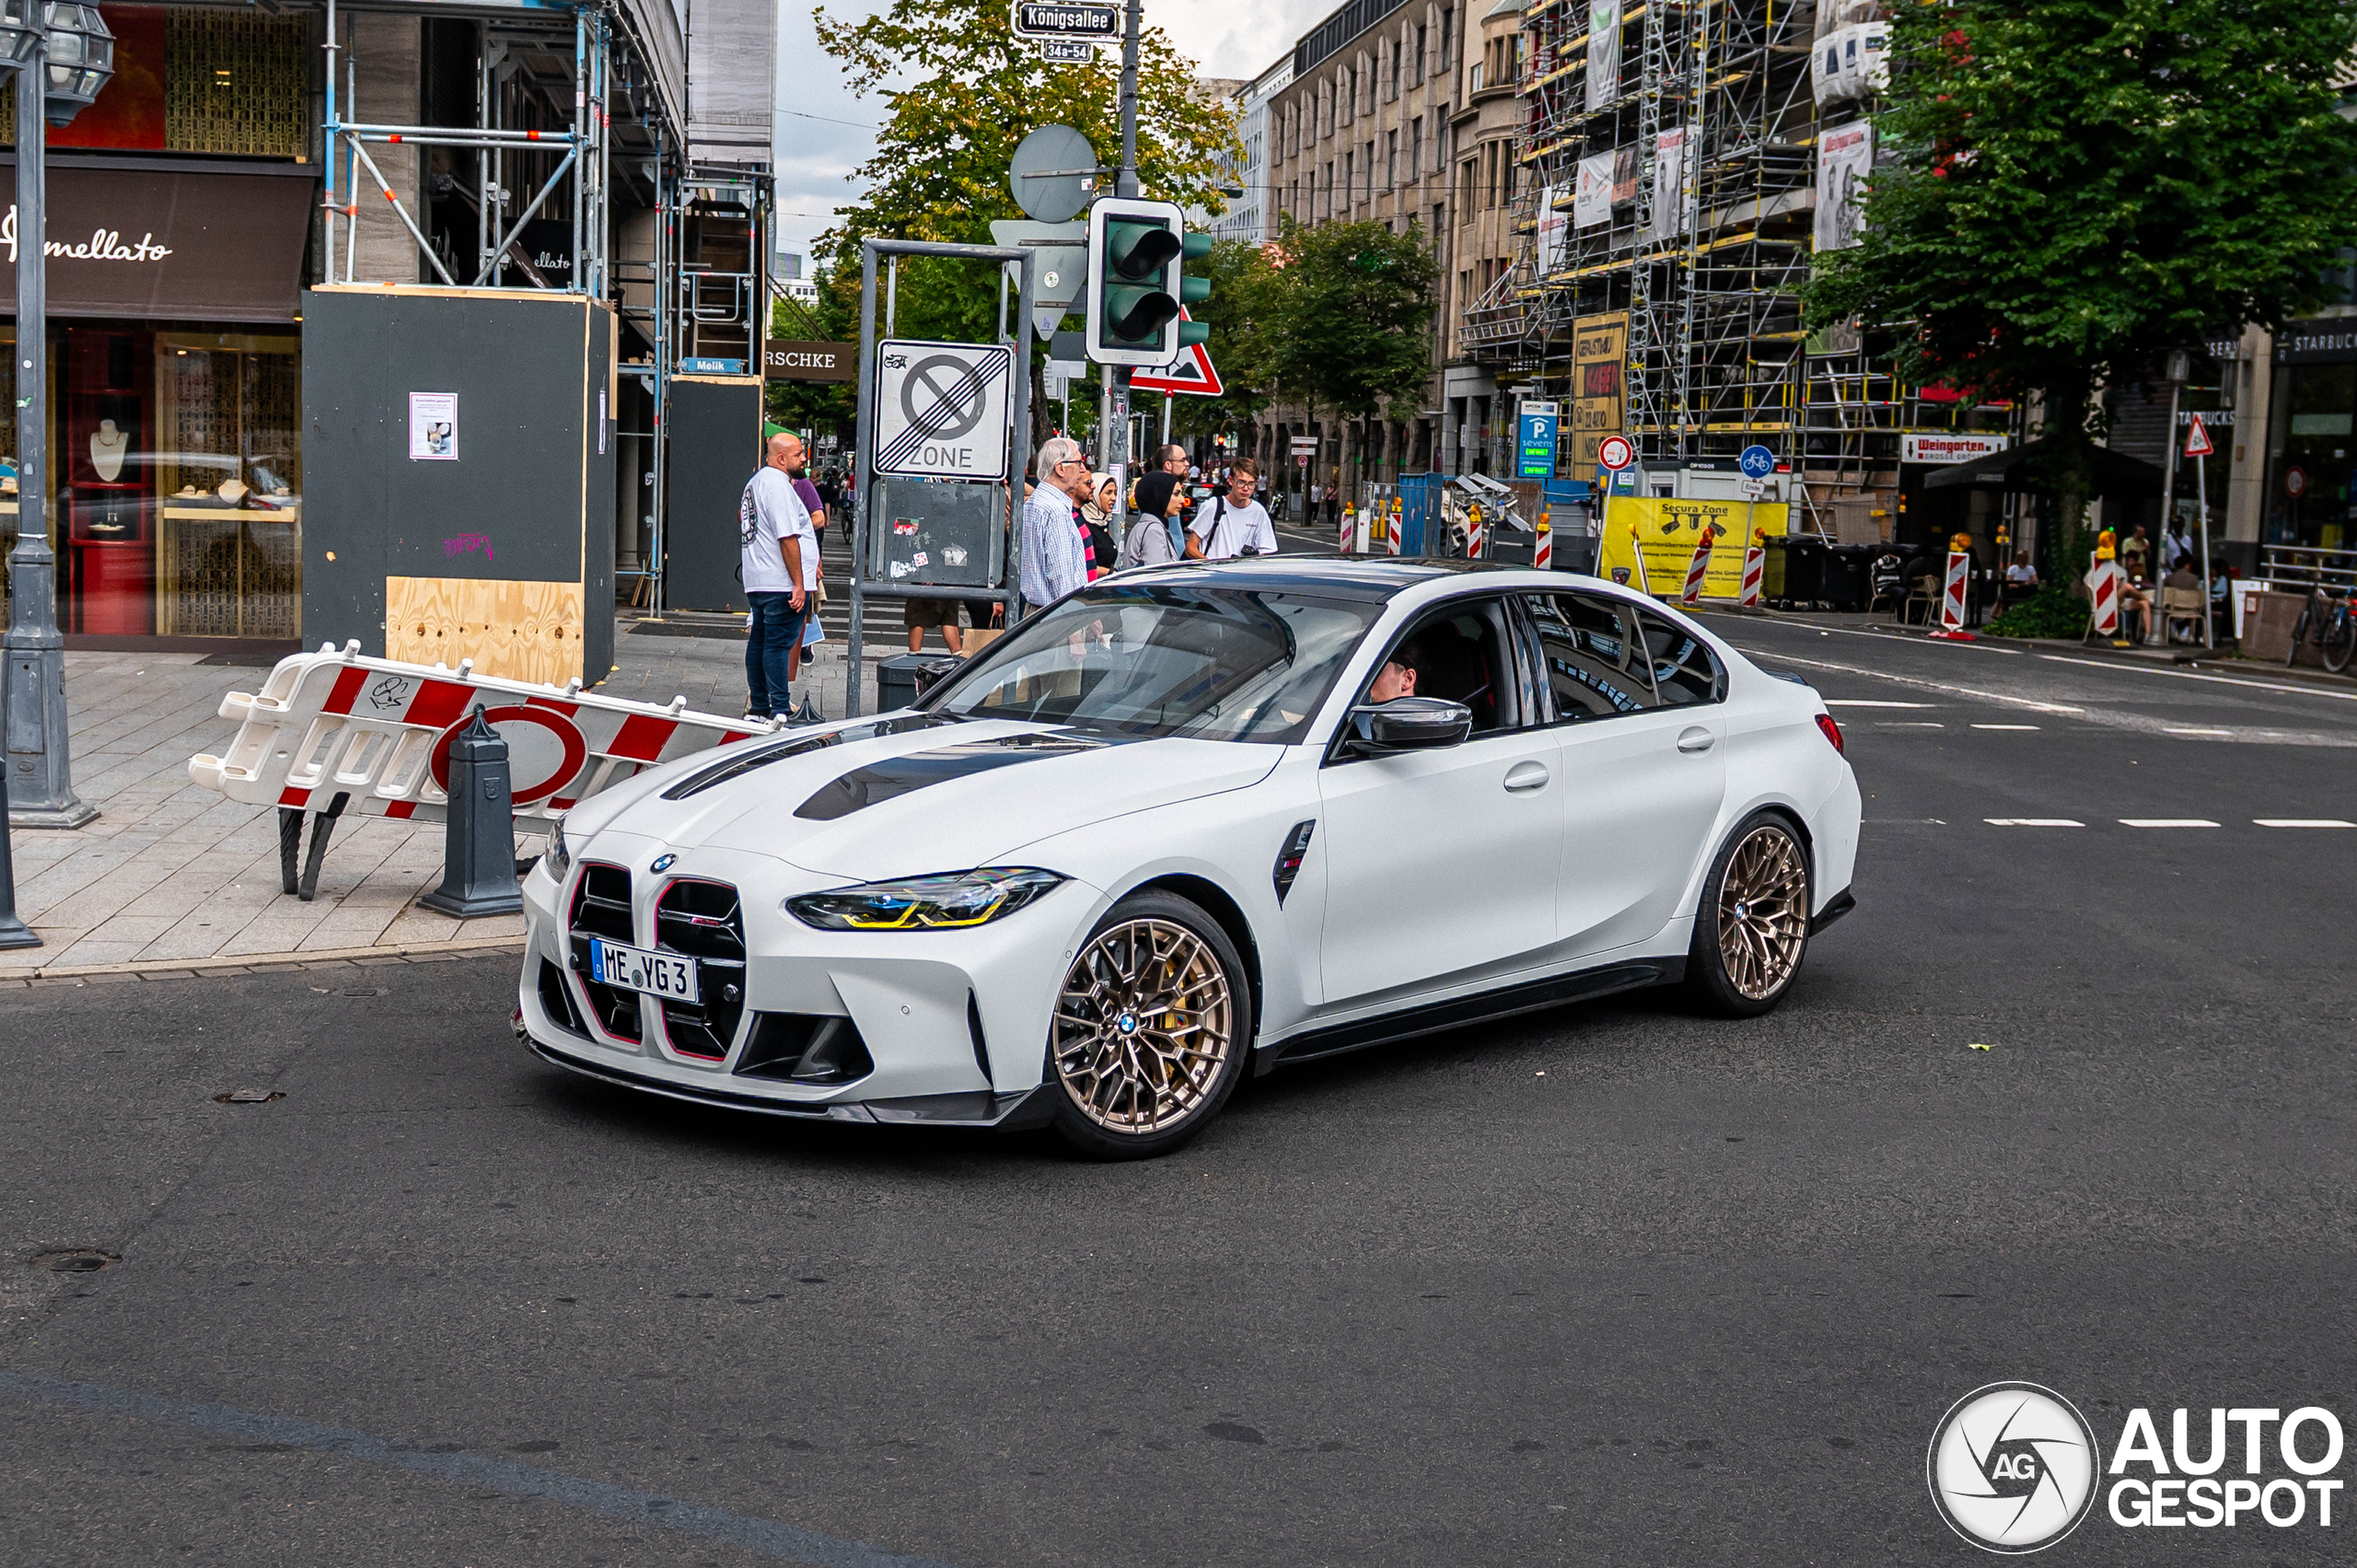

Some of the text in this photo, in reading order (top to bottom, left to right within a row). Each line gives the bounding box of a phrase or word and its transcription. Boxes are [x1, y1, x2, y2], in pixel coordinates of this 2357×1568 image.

[1028, 6, 1109, 29] Königsallee
[1048, 44, 1086, 58] 34a-54
[697, 360, 725, 371] Melik
[766, 352, 835, 368] RSCHKE
[1522, 440, 1553, 448] sevens
[1918, 439, 1985, 453] Weingarten
[909, 446, 973, 469] ZONE
[1746, 483, 1760, 492] Ende
[1662, 504, 1728, 516] Secura Zone
[596, 964, 601, 973] D
[604, 947, 630, 984] ME
